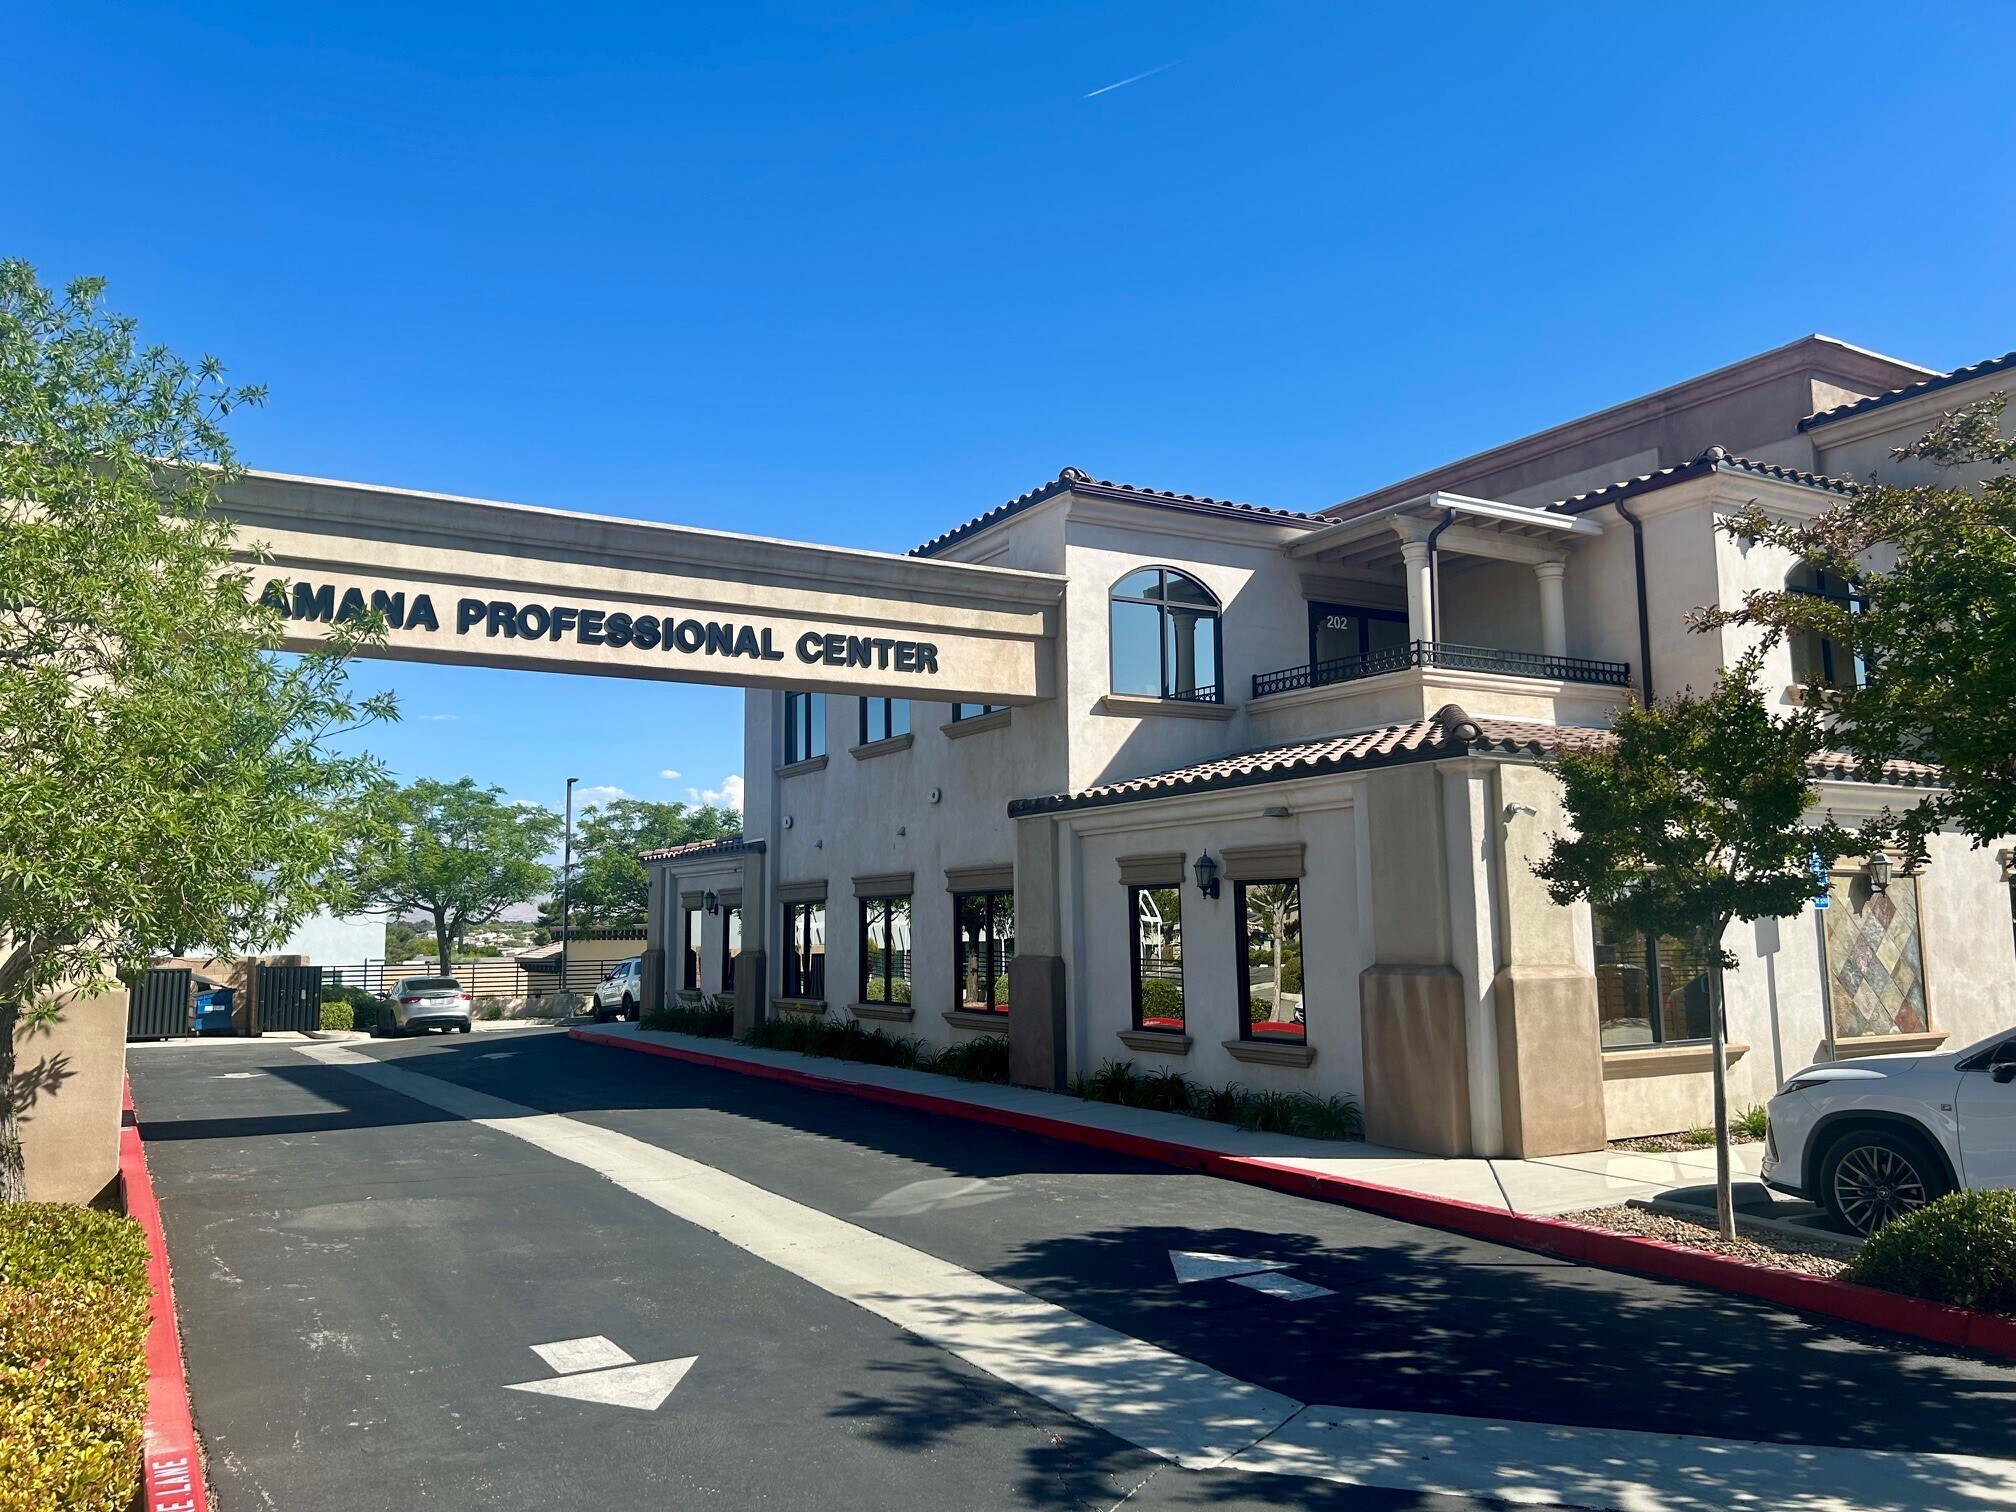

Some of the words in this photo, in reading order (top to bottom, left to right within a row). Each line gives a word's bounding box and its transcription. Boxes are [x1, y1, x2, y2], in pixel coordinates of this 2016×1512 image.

[457, 598, 784, 661] PROFESSIONAL
[795, 631, 938, 674] CENTER
[1327, 615, 1347, 630] 202
[152, 1457, 191, 1496] LANE
